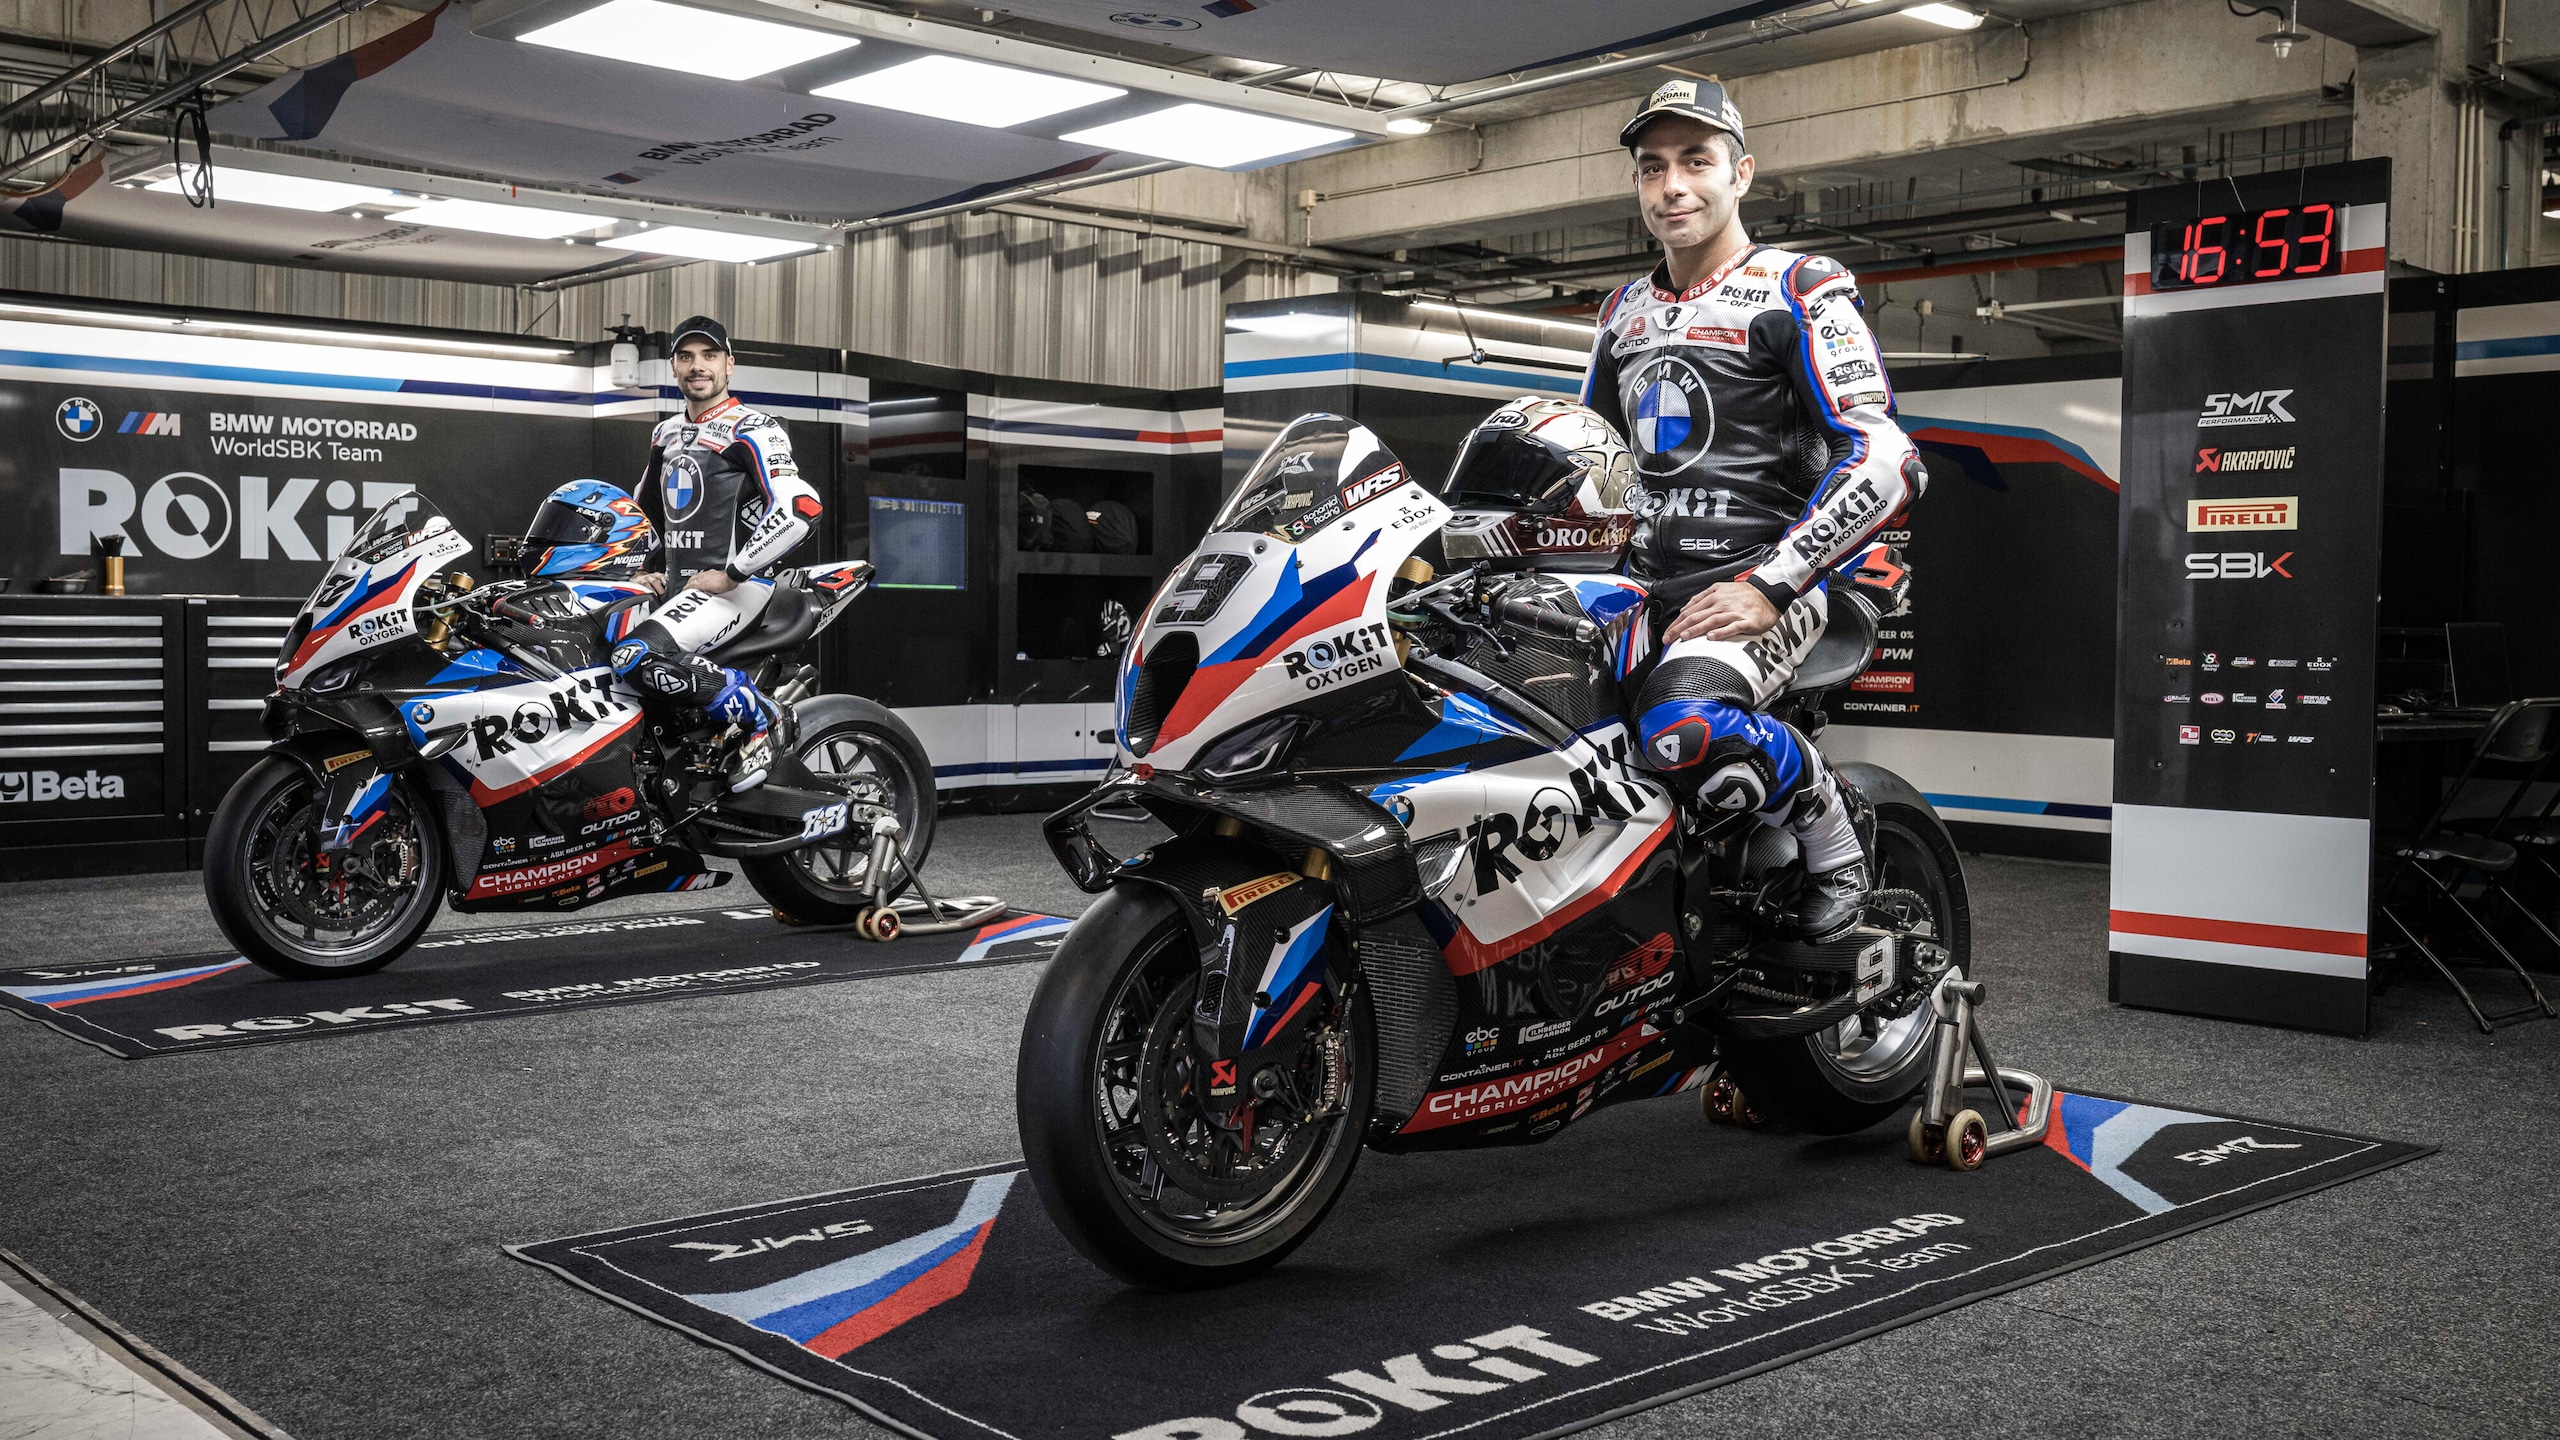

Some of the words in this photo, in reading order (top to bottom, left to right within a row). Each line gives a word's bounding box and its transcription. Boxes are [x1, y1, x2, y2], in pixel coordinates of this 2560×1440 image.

[2179, 204, 2335, 284] 16:53
[1743, 266, 1779, 280] PIRELI
[1730, 300, 1751, 308] OFF
[1690, 328, 1738, 338] CHAMPION
[1820, 319, 1860, 339] ebc
[1618, 337, 1650, 349] OUTDO
[1633, 362, 1699, 399] BMW
[61, 399, 98, 414] BMW
[701, 403, 730, 423] IXON
[2200, 389, 2297, 423] SMR
[210, 412, 274, 434] BMW
[282, 416, 418, 441] MOTORRAD
[2200, 415, 2265, 426] PERFORMANCE
[210, 436, 323, 460] WorldSBK
[328, 441, 383, 463] Team
[666, 458, 698, 477] BMW
[1345, 465, 1401, 507] WRS
[1302, 496, 1338, 523] Bonamici
[1313, 506, 1341, 525] Racing
[1391, 505, 1437, 529] EDOX
[1793, 478, 1882, 562] ROKiT
[2197, 503, 2288, 526] PIRELLI
[748, 542, 764, 559] BMW
[764, 521, 795, 547] MOTORRAD
[1679, 538, 1732, 551] SBK
[1808, 544, 1832, 570] BMW
[1834, 499, 1889, 547] MOTORRAD
[429, 543, 461, 556] EDOX
[613, 554, 647, 569] NOLAN
[2184, 551, 2295, 580] SBK
[664, 589, 713, 624] ROK
[348, 608, 408, 639] ROKiT
[360, 625, 405, 646] OXYGEN
[1900, 630, 1915, 640] 0%
[1283, 622, 1388, 680] ROKiT
[1882, 648, 1914, 661] PVM
[2173, 658, 2192, 666] Beta
[1306, 653, 1383, 690] OXYGEN
[1854, 674, 1911, 684] CHAMPION
[1843, 702, 1920, 713] CONTAINER.IT
[32, 769, 126, 801] Beta
[581, 810, 641, 836] OUTDO
[625, 825, 647, 836] PVM
[492, 836, 516, 847] ebc
[565, 844, 583, 854] BEER
[585, 840, 597, 848] 0%
[479, 852, 598, 889] CHAMPION
[496, 868, 583, 893] LUBRICANTS
[1223, 873, 1295, 909] PIRELLI
[1855, 935, 1895, 1006] 9
[1594, 971, 1675, 1018] OUTDO
[1645, 993, 1676, 1014] PVM
[153, 998, 475, 1041] ROKiT
[1465, 1026, 1500, 1044] ebc
[1567, 1034, 1592, 1051] BEER
[1594, 1026, 1609, 1039] 0%
[1466, 1045, 1496, 1057] group
[1428, 1047, 1605, 1114] CHAMPION
[1440, 1059, 1525, 1083] CONTAINER.IT
[1452, 1075, 1579, 1120] LUBRICANTS
[2174, 1136, 2302, 1167] SMR
[1579, 1275, 1727, 1322] BMW
[1712, 1211, 1966, 1284] MOTORRAD
[1632, 1267, 1875, 1337] WorldSBK
[1868, 1240, 1974, 1275] Team
